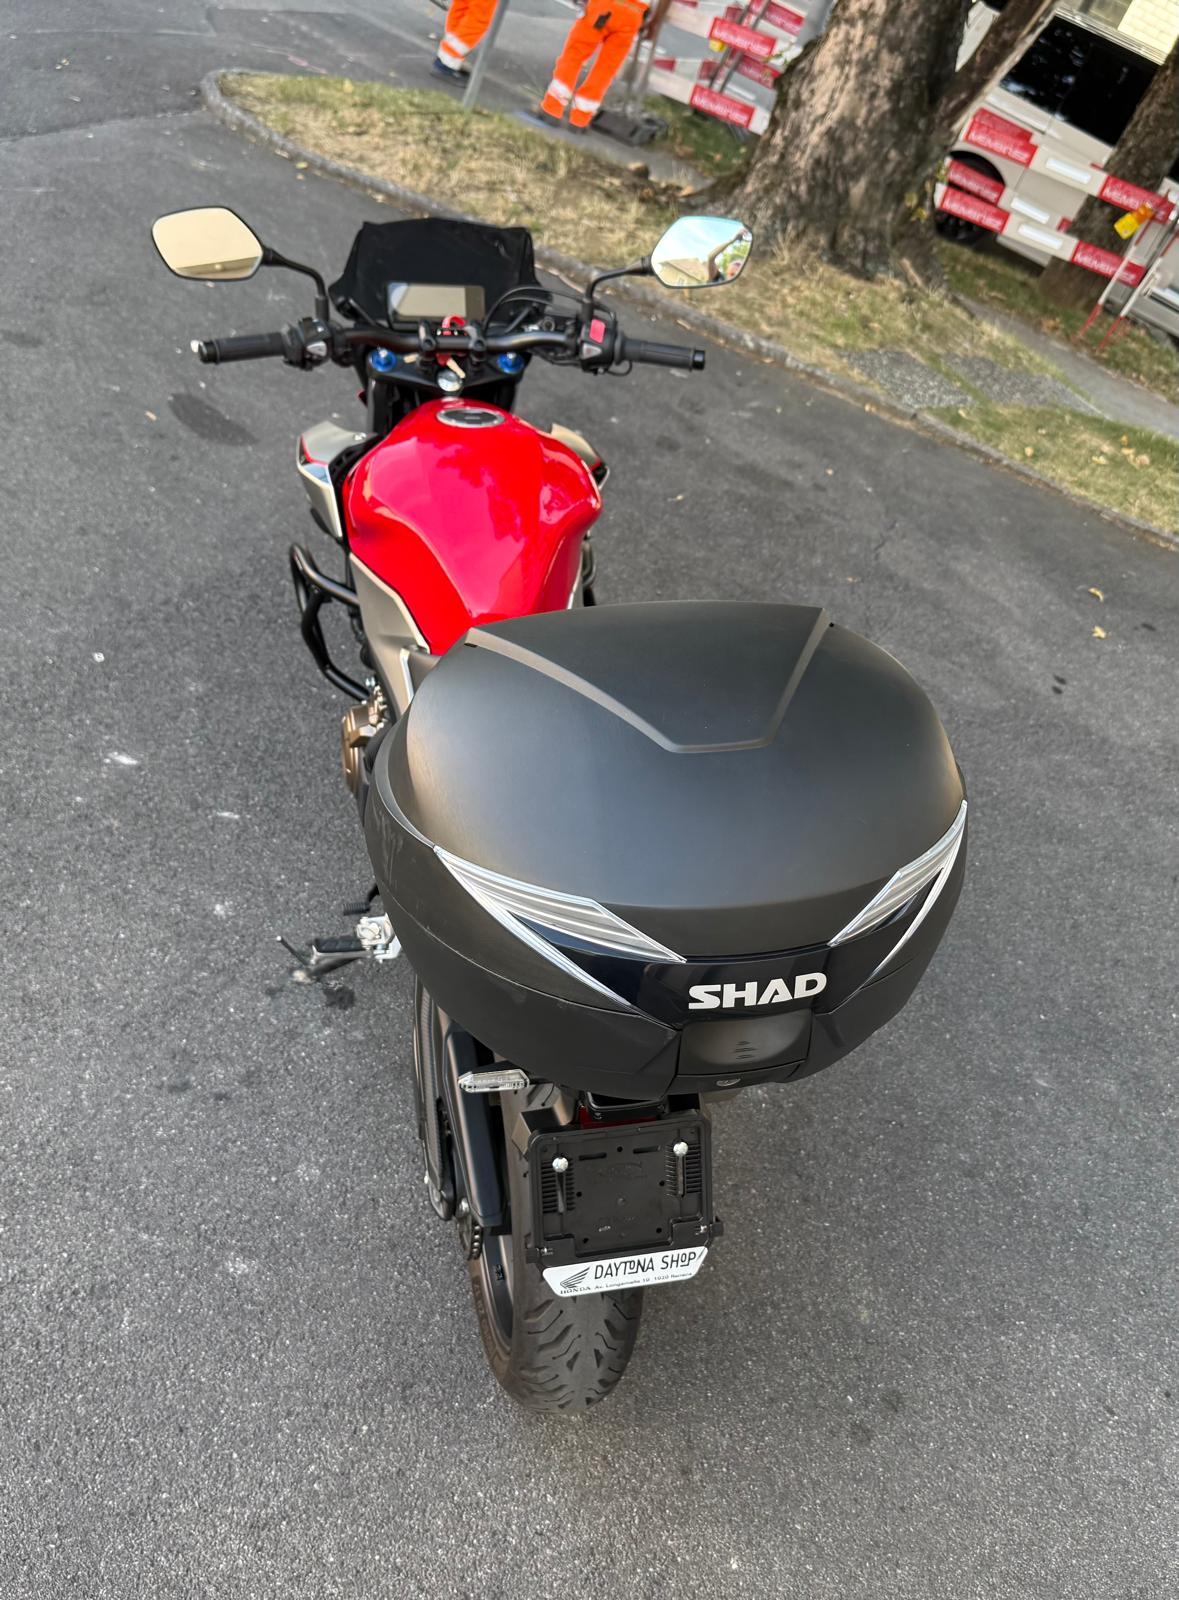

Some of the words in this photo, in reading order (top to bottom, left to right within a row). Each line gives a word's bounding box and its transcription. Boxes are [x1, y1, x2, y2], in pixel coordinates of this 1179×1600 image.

[688, 972, 828, 1010] SHAD
[594, 1257, 655, 1280] DAYTONA
[660, 1251, 697, 1270] SHOP
